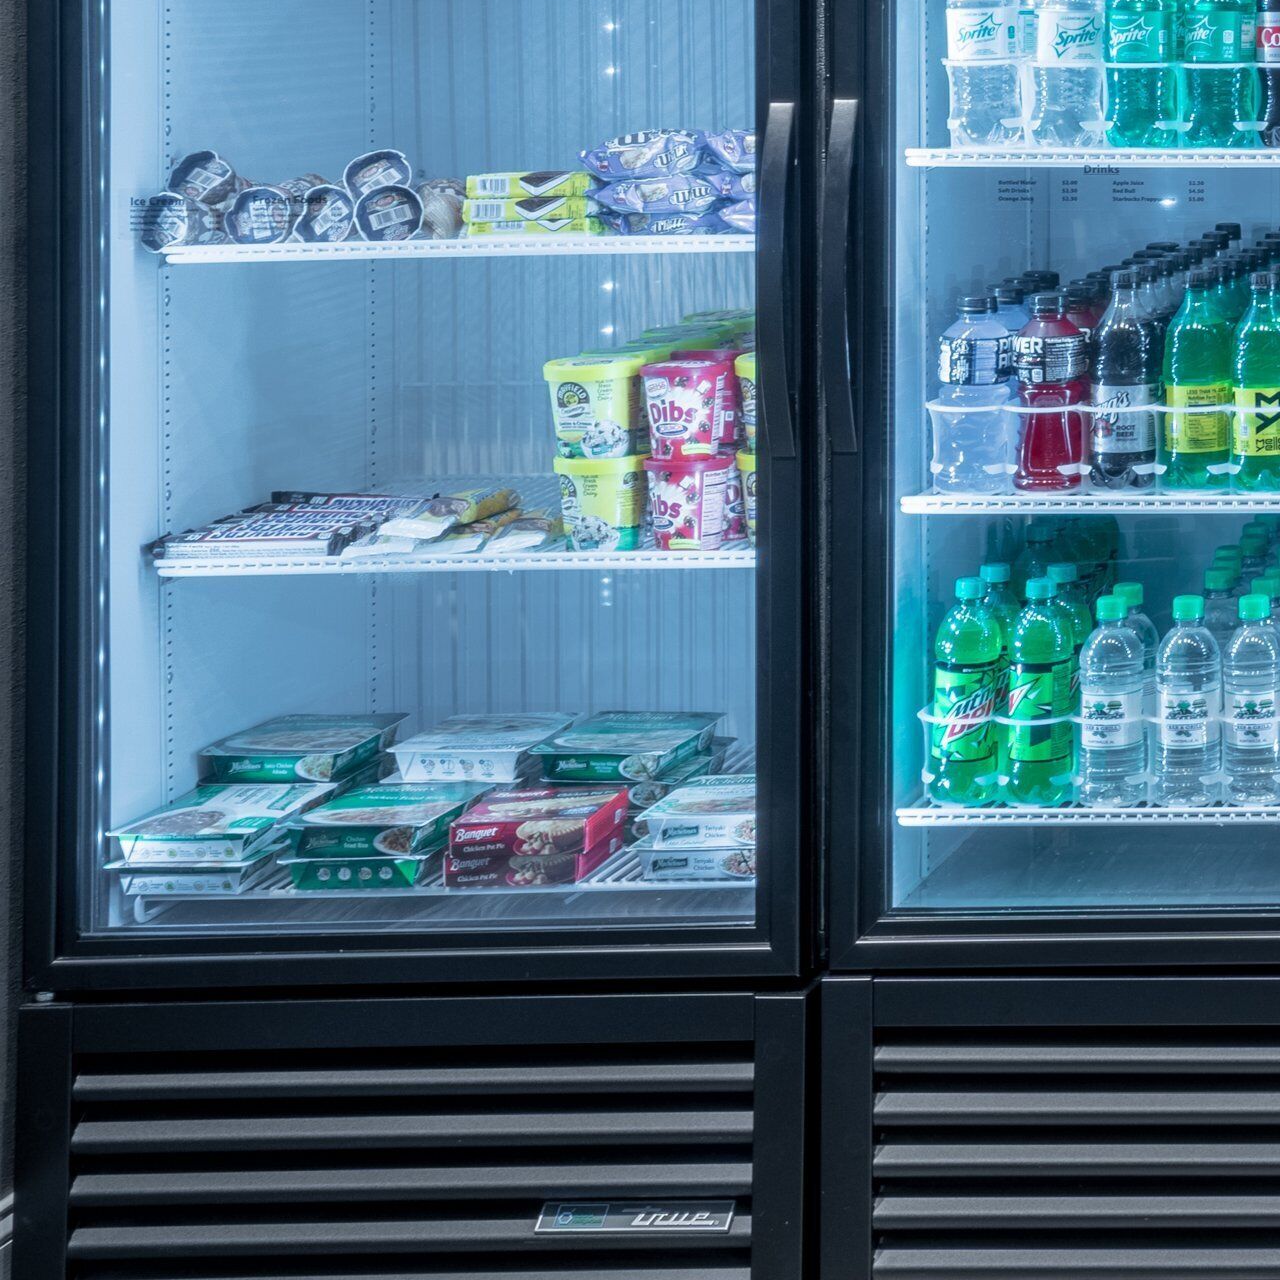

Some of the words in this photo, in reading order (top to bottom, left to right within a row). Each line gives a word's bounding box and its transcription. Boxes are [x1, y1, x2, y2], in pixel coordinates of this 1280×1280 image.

[956, 23, 996, 43] Sprite
[1055, 28, 1097, 47] Sprite
[1110, 26, 1148, 43] Sprite
[1083, 165, 1120, 174] Drinks
[130, 197, 146, 206] Ice
[252, 195, 291, 205] Frozen
[649, 399, 698, 424] Dibs
[455, 827, 499, 842] Banquet
[463, 845, 485, 853] Chicken
[486, 844, 496, 852] Pot
[450, 857, 491, 871] Banquet
[457, 875, 478, 883] Chicken
